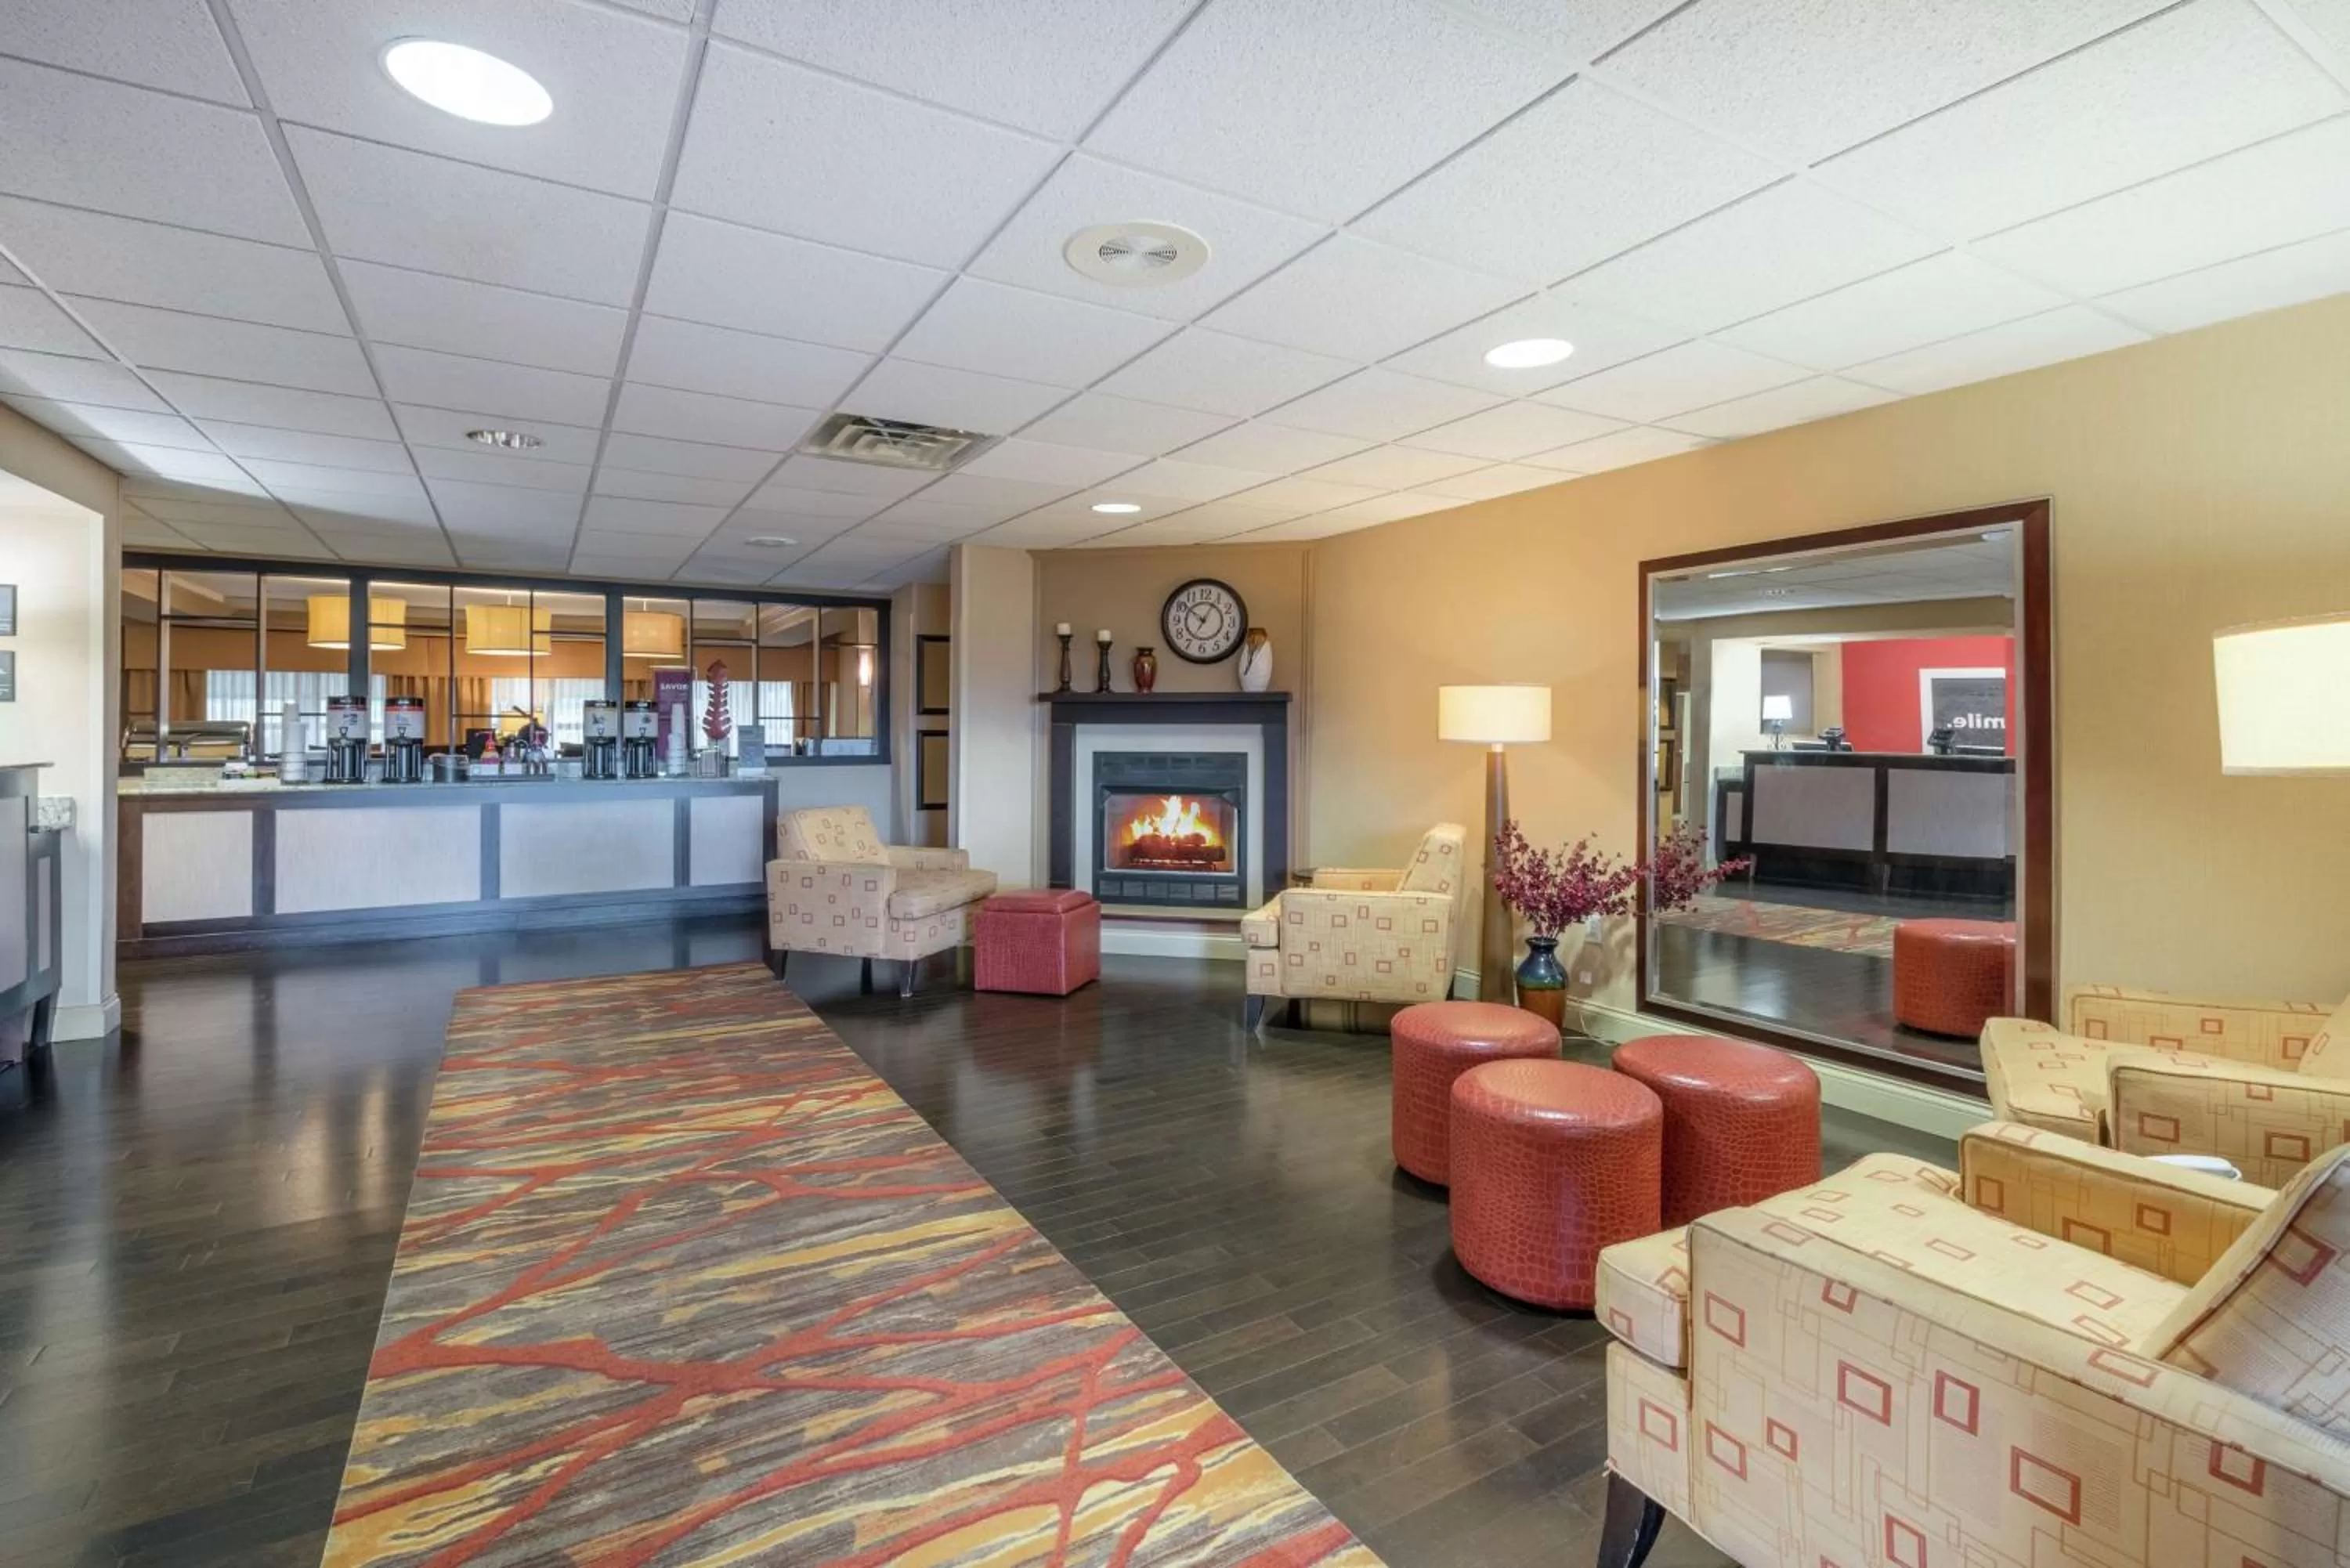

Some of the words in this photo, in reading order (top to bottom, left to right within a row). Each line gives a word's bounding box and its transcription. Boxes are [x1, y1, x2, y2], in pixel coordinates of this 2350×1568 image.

[1187, 591, 1196, 602] 11
[1200, 588, 1212, 601] 12
[1224, 602, 1232, 615] 2
[1173, 614, 1180, 625] 9
[1227, 616, 1235, 627] 3
[1177, 627, 1184, 639] 8
[1223, 630, 1230, 641] 4
[1184, 638, 1192, 649] 7
[1198, 643, 1206, 653] 6
[1212, 641, 1220, 652] 5
